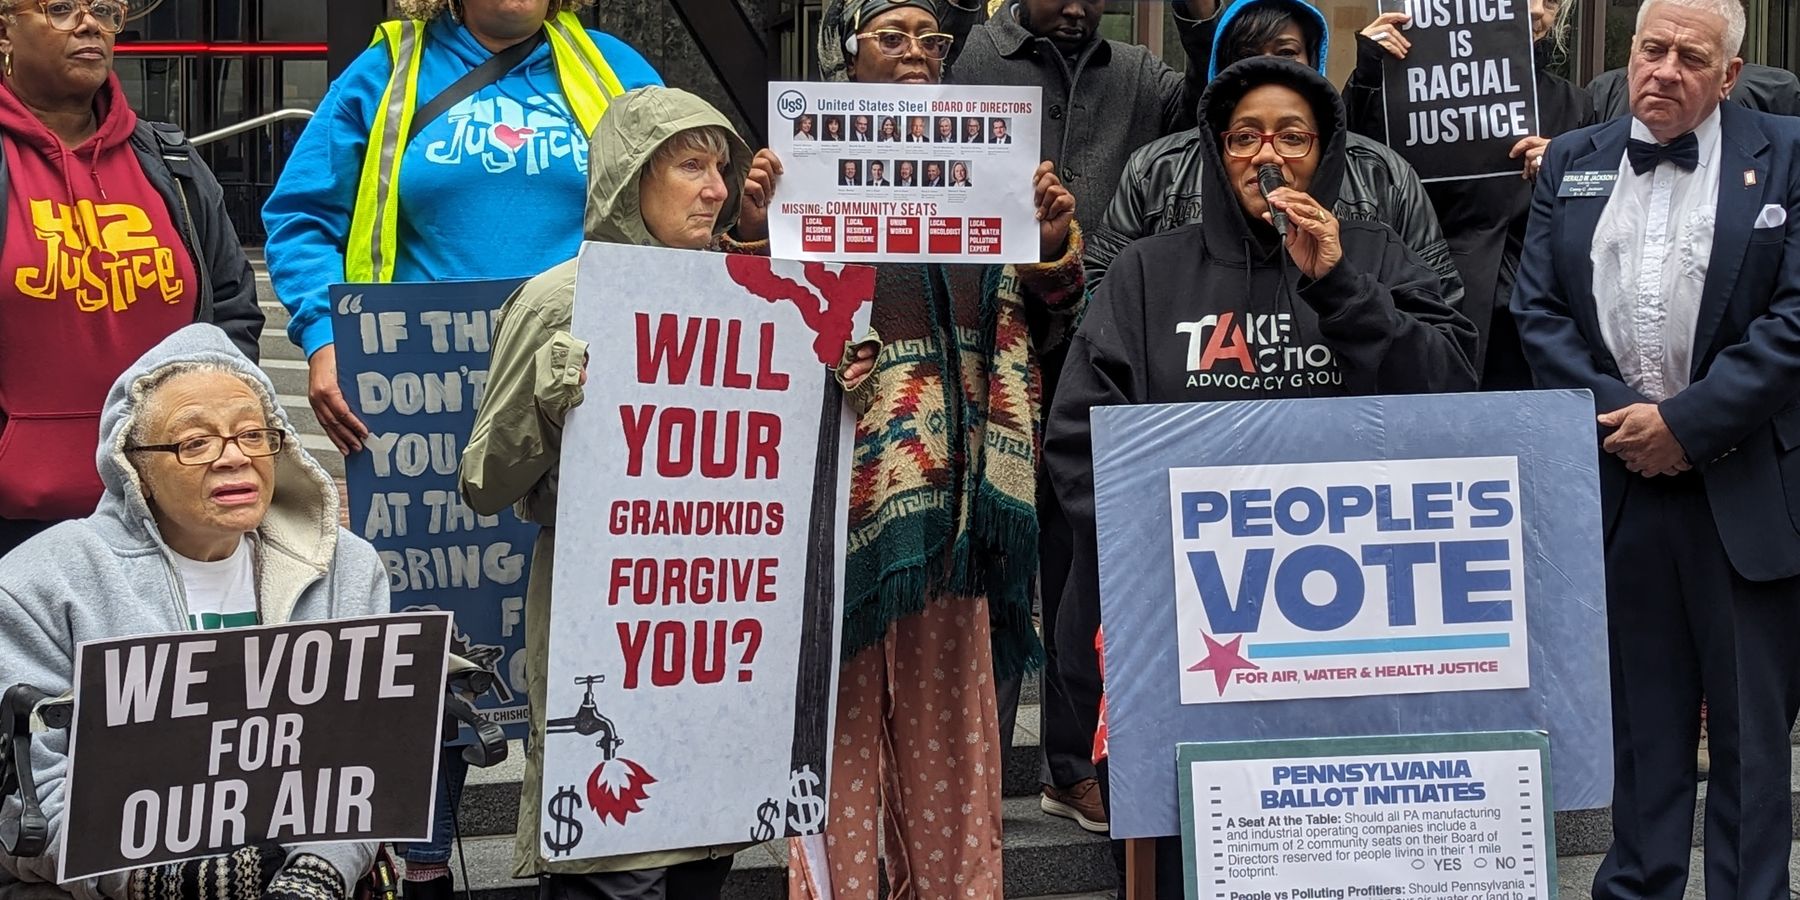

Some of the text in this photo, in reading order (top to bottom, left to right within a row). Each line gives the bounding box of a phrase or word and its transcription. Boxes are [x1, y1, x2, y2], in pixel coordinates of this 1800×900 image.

[1402, 0, 1514, 31] JUSTICE
[1449, 30, 1473, 58] IS
[1407, 58, 1520, 102] RACIAL
[817, 98, 1032, 114] United States Steel BOARD OF DIRECTORS
[1405, 101, 1529, 146] JUSTICE
[782, 201, 937, 215] MISSING: COMMUNITY SEATS
[805, 217, 823, 225] LOCAL
[846, 218, 864, 226] LOCAL
[29, 197, 160, 251] 412
[805, 226, 832, 234] RESIDENT
[846, 226, 873, 234] RESIDENT
[889, 227, 913, 235] WORKER
[969, 219, 986, 227] LOCAL
[634, 312, 790, 391] WILL
[1175, 311, 1292, 373] TAKE
[356, 365, 489, 415] DON'T
[1186, 371, 1342, 390] ADVOCACY GROU
[362, 432, 457, 477] YOU
[619, 405, 782, 479] YOUR
[365, 490, 499, 540] AT TH
[609, 499, 784, 536] GRANDKIDS
[1181, 479, 1514, 540] PEOPLE'S
[378, 542, 525, 592] BRING
[608, 557, 779, 605] FORGIVE
[1186, 538, 1514, 634] VOTE
[616, 618, 763, 690] YOU?
[105, 640, 217, 727] WE
[244, 622, 422, 710] VOTE
[1236, 661, 1499, 684] FOR AIR, WATER & HEALTH JUSTICE
[493, 708, 529, 722] CHISHO
[208, 713, 304, 776] FOR
[1272, 759, 1473, 786] PENNSYLVANIA
[1260, 781, 1486, 810] BALLOT INITIATES
[120, 766, 375, 860] OUR AIR
[1226, 808, 1501, 828] A Seat At the Table: Should all PA manufacturing
[1226, 821, 1477, 841] and industrial operating companies include a
[1227, 830, 1498, 853] minimum of 2 community seats on their Board of
[1228, 853, 1279, 865] Directors
[1282, 850, 1333, 863] reserved
[1336, 849, 1351, 860] for
[1354, 848, 1392, 863] people
[1427, 845, 1437, 856] in
[1440, 845, 1465, 855] their
[1468, 844, 1474, 854] 1
[1478, 843, 1501, 854] mile
[1433, 856, 1516, 871] YES NO
[1228, 866, 1278, 879] footprint.
[1230, 890, 1271, 900] People
[1274, 891, 1288, 900] vs
[1291, 887, 1344, 900] Polluting
[1348, 884, 1406, 897] Profitiers:
[1408, 881, 1448, 894] Should
[1451, 878, 1525, 892] Pennsylvania
[1512, 891, 1524, 900] to
